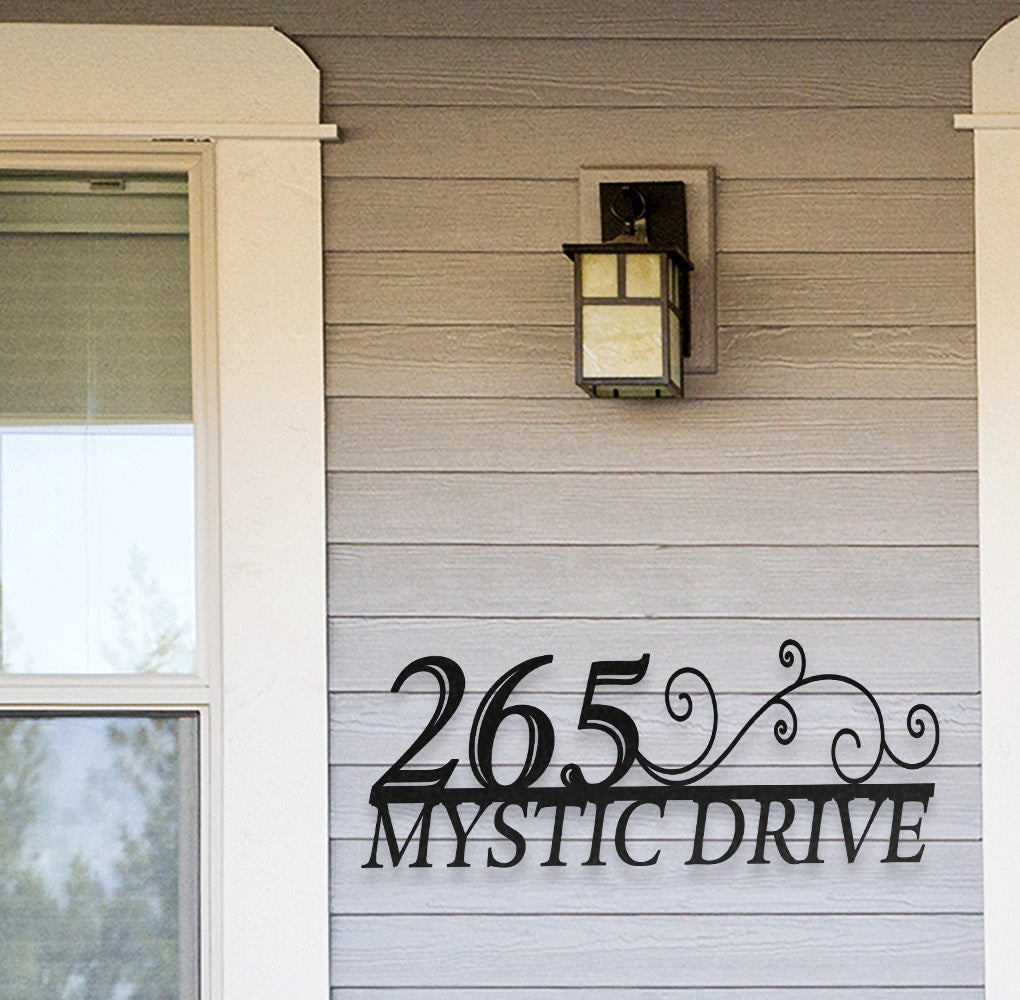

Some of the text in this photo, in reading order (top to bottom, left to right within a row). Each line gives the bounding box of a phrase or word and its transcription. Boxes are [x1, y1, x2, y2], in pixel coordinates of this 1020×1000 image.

[372, 653, 650, 789] 265
[361, 796, 931, 868] MYSTIC DRIVE
